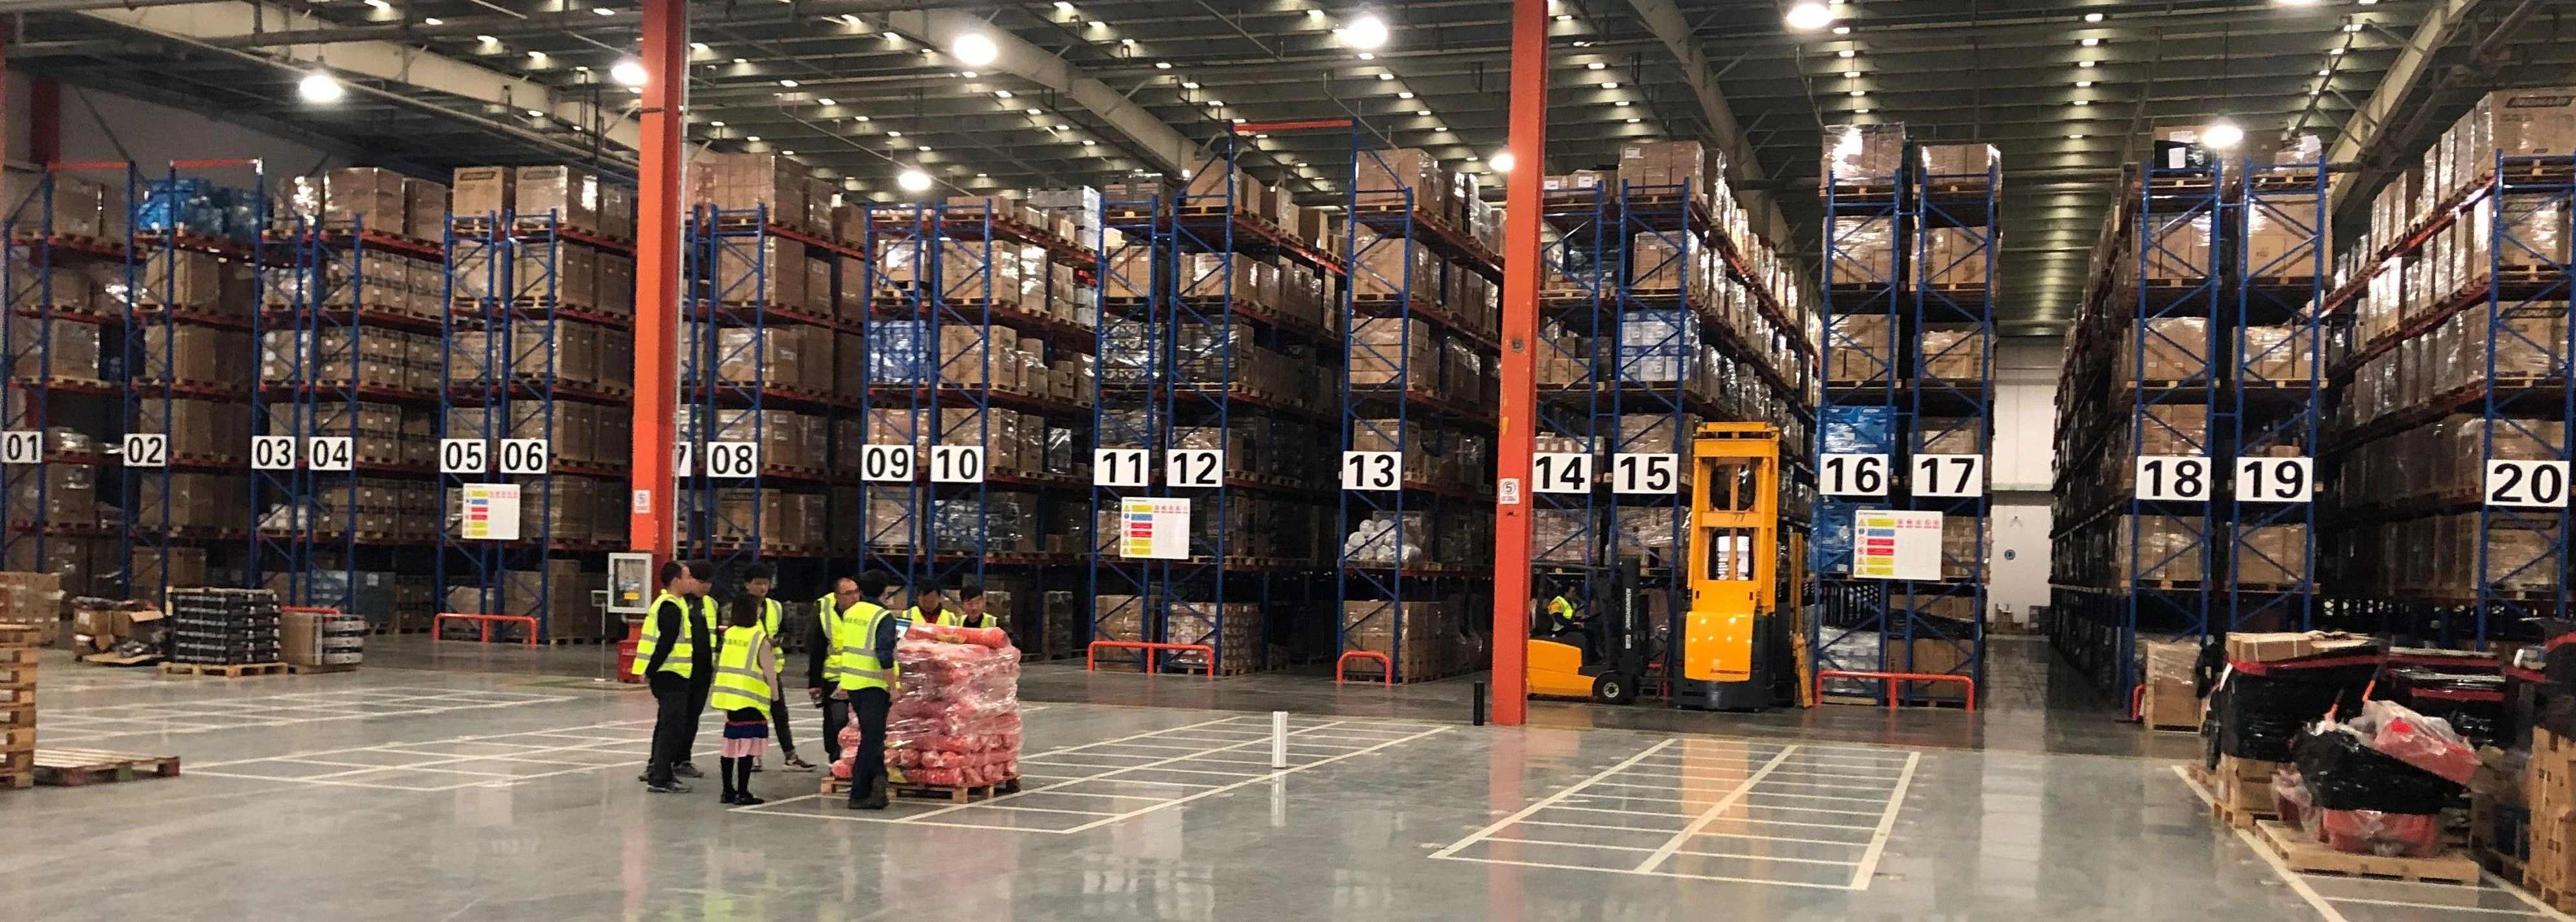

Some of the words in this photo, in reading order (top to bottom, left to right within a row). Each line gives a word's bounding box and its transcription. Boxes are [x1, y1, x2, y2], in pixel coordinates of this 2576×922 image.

[7, 434, 37, 460] 01
[128, 437, 162, 463] 02
[257, 439, 290, 466] 03
[313, 440, 348, 467] 04
[446, 442, 482, 469] 05
[505, 442, 542, 471] 06
[674, 445, 687, 467] 7
[712, 445, 752, 475] 08
[867, 448, 908, 478] 09
[938, 449, 977, 479] 10
[1103, 453, 1140, 483] 11
[1174, 453, 1216, 484] 12
[1350, 455, 1394, 487] 13
[1536, 456, 1584, 490] 14
[1621, 456, 1670, 490] 15
[1827, 457, 1880, 492] 16
[1921, 458, 1974, 493] 17
[2144, 460, 2202, 497] 18
[2245, 461, 2303, 498] 19
[2492, 464, 2561, 503] 20
